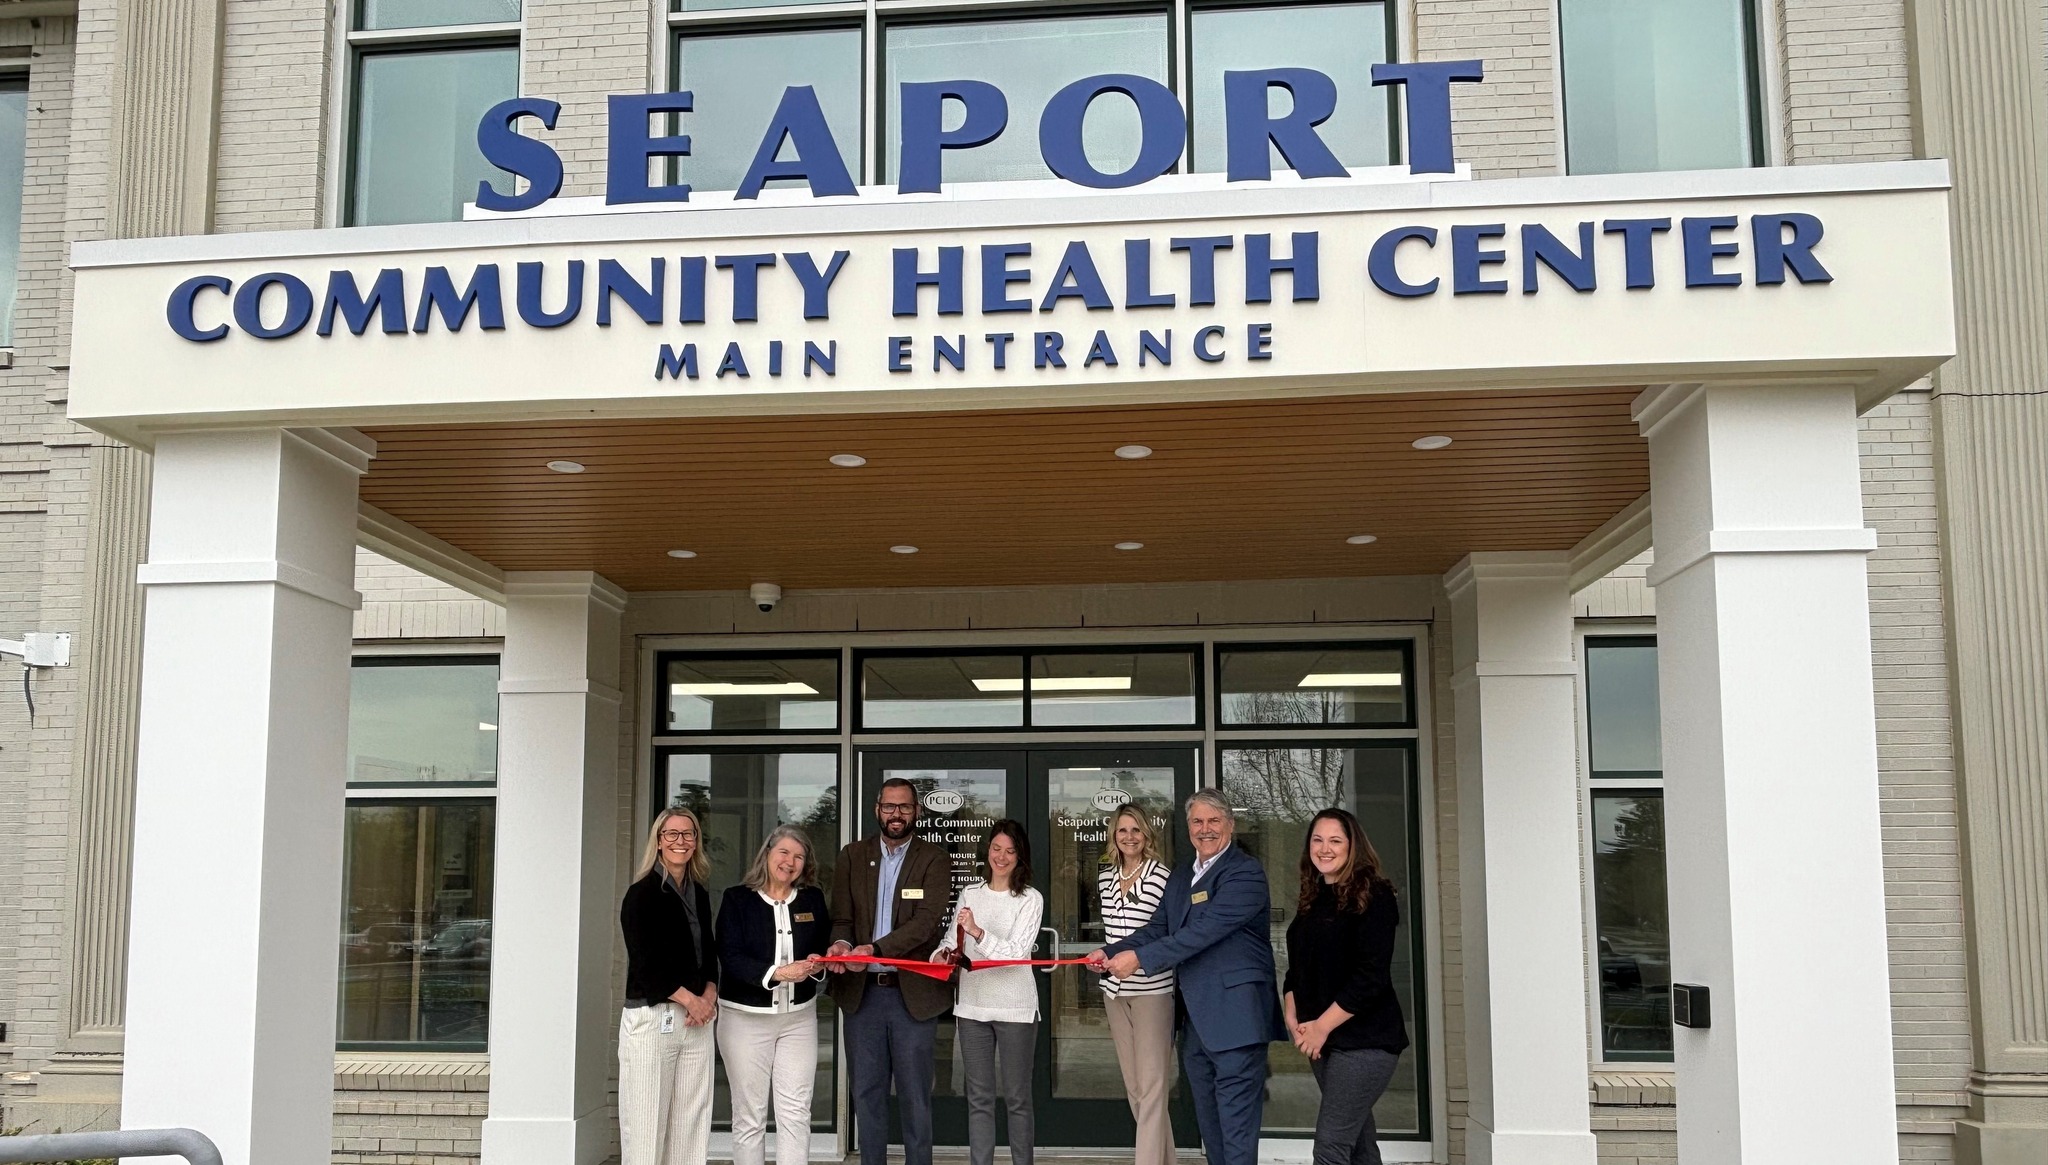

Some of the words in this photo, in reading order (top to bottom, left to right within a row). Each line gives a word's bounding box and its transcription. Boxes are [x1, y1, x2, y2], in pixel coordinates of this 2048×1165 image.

[476, 60, 1483, 211] SEAPORT
[167, 250, 850, 342] COMMUNITY
[892, 232, 1320, 316] HEALTH
[1368, 213, 1833, 297] CENTER
[656, 340, 837, 380] MAIN
[889, 323, 1274, 373] ENTRANCE
[929, 796, 958, 805] PCHC
[1098, 795, 1127, 804] PCHC
[1057, 816, 1099, 829] Seaport
[945, 832, 982, 843] Center
